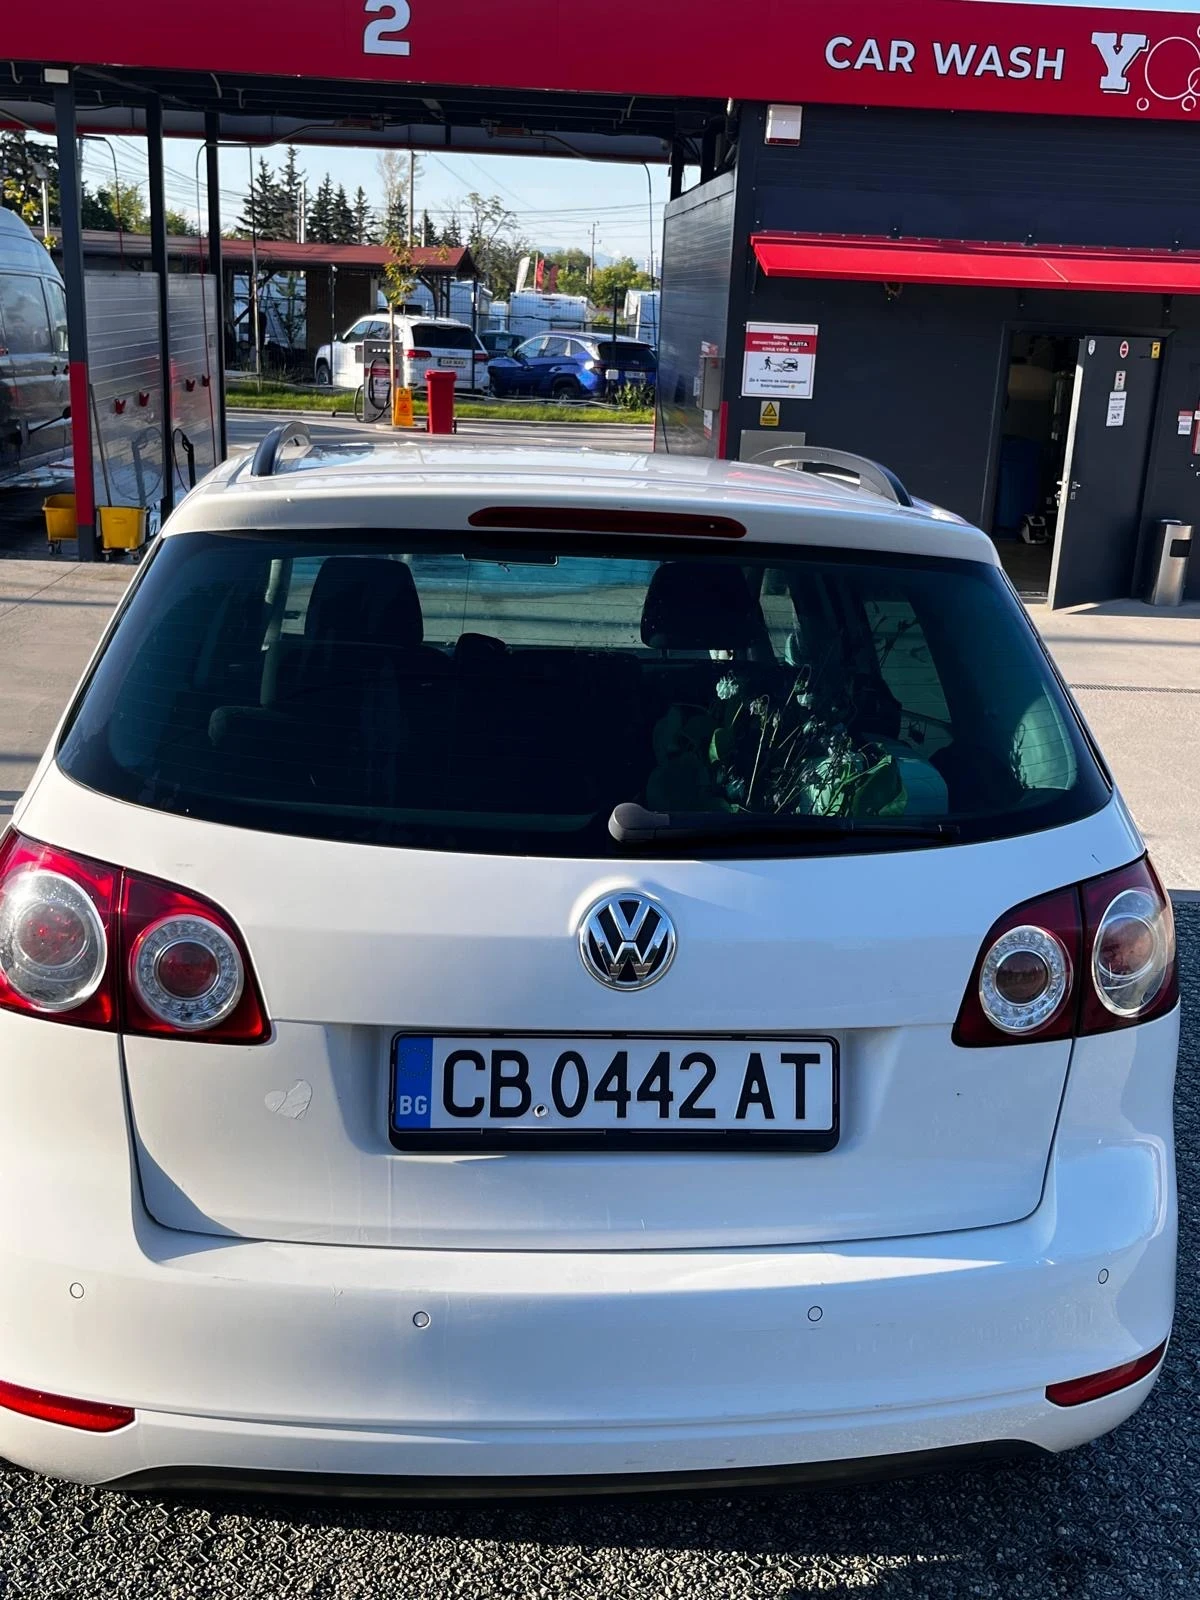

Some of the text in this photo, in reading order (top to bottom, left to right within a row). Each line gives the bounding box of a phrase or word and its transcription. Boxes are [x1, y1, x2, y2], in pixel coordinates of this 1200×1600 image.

[364, 0, 410, 56] 2
[825, 36, 1065, 80] CAR WASH
[399, 1095, 428, 1115] BG
[442, 1049, 821, 1120] CB 0442 AT
